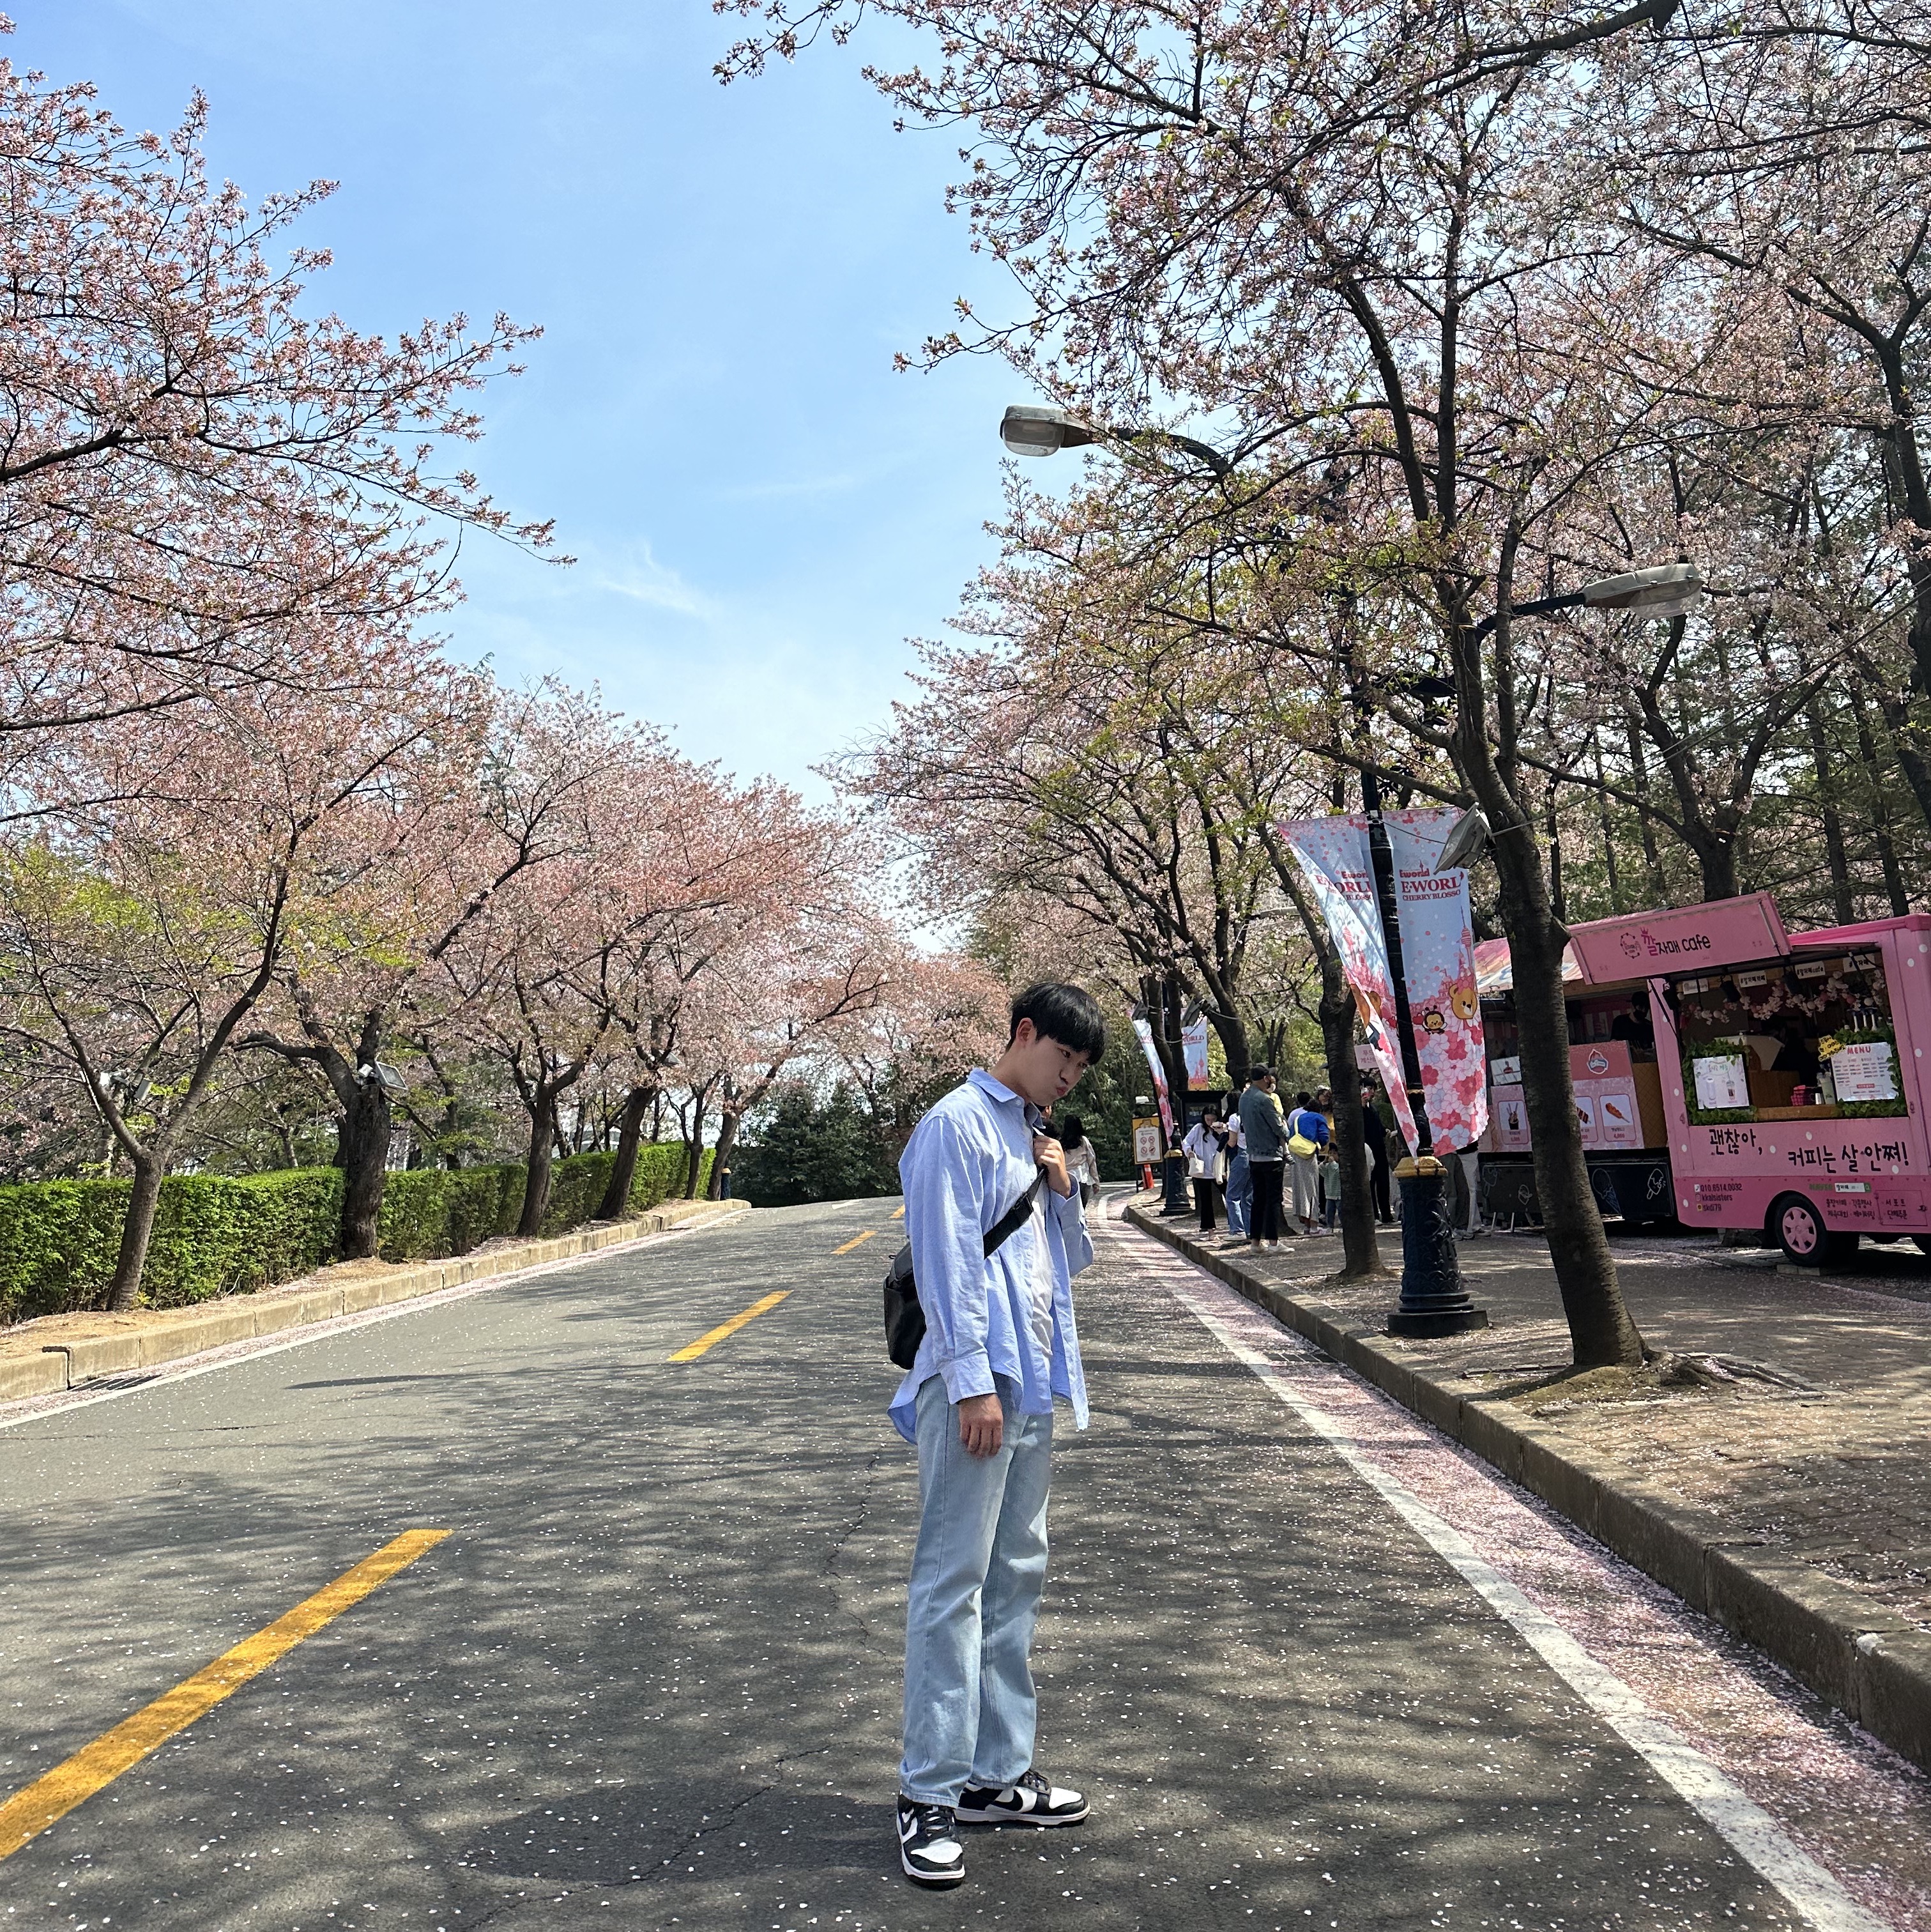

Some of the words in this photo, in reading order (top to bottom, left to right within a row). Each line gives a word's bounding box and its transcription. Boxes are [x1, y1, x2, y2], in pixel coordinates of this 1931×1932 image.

[1399, 867, 1430, 877] Eworld
[1641, 934, 1682, 956] 깔자매
[1682, 933, 1711, 952] cafe
[1847, 1046, 1871, 1054] MENU
[1709, 1128, 1762, 1155] 괜찮아,
[1788, 1145, 1836, 1174] 커피는
[1842, 1144, 1858, 1172] 살
[1865, 1141, 1909, 1172] 안쪄!
